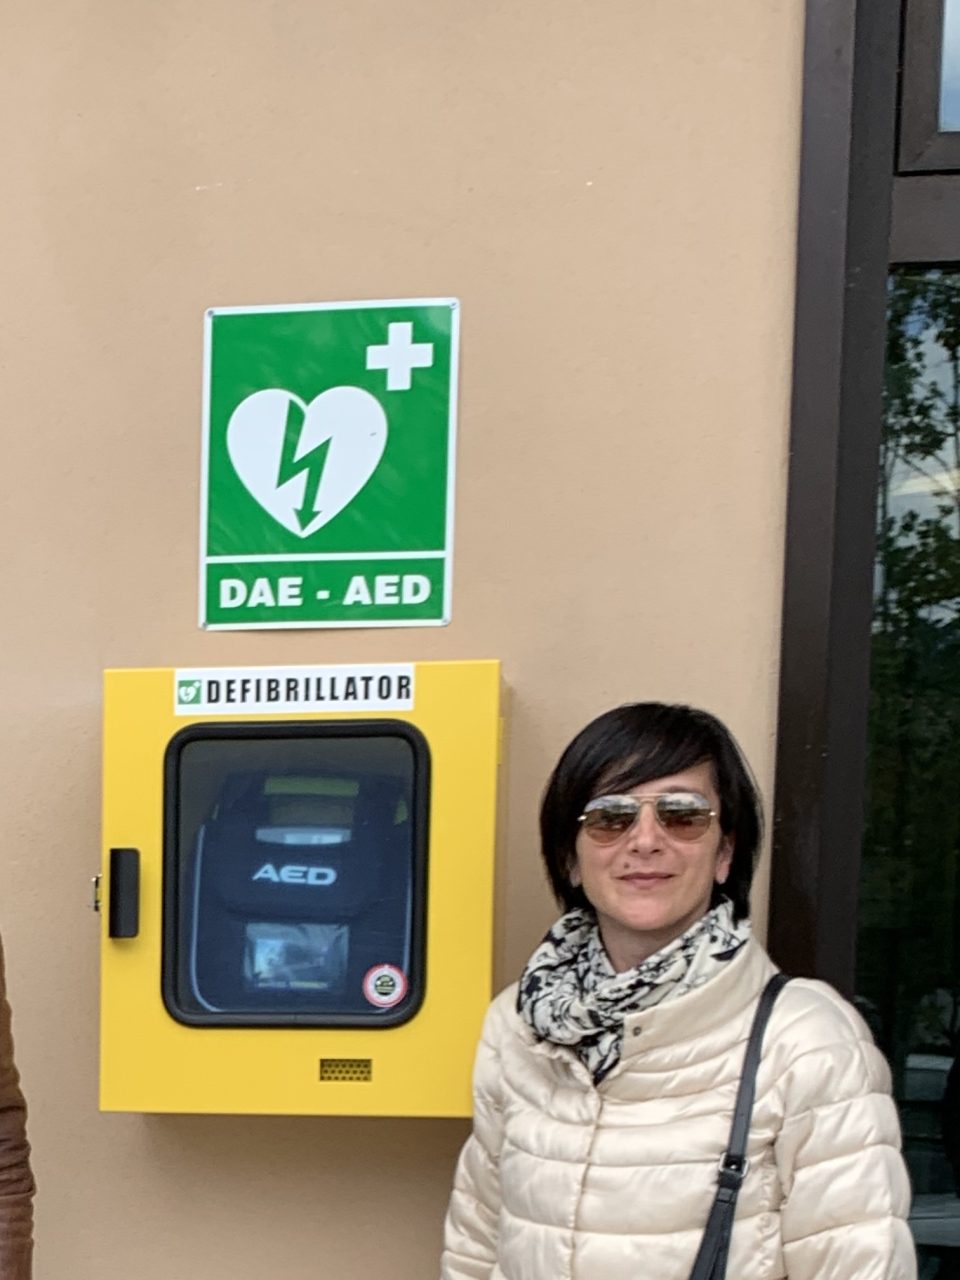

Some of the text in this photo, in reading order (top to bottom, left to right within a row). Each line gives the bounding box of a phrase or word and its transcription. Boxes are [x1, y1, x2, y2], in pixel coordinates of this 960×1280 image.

[219, 577, 303, 608] DAE
[342, 574, 432, 606] AED
[207, 675, 412, 704] DEFIBRILLATOR
[252, 863, 338, 886] AED
